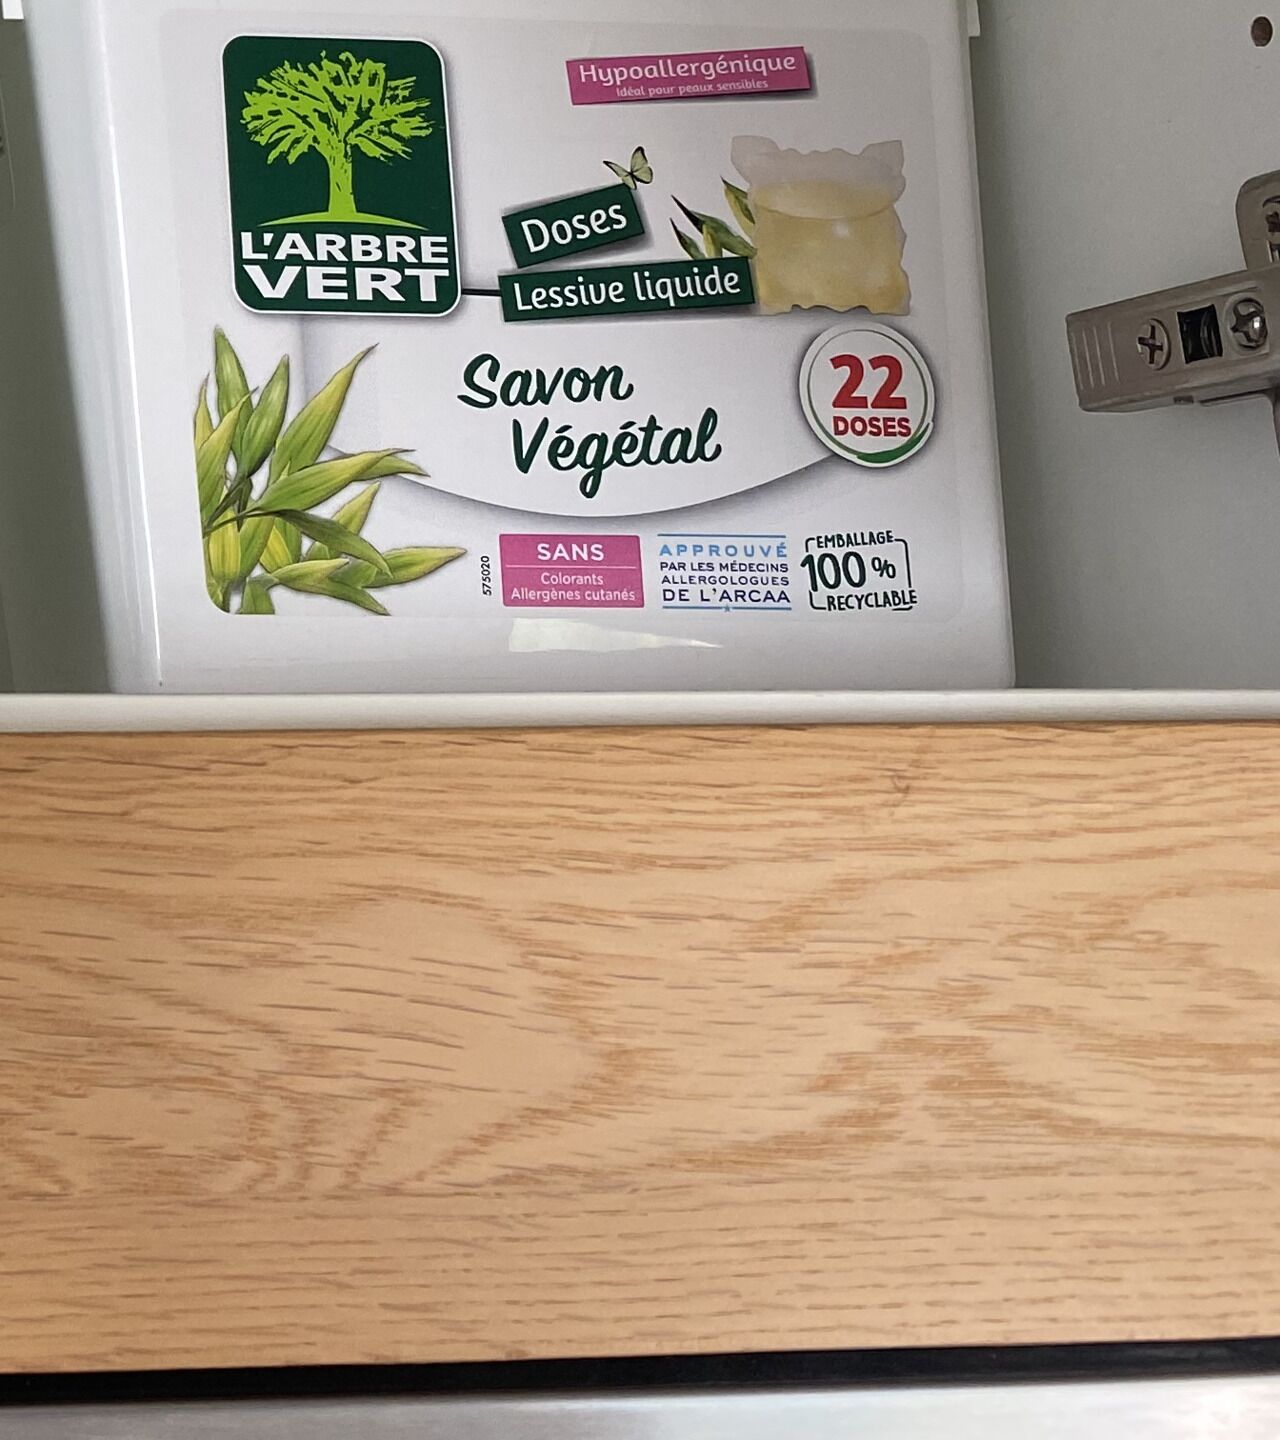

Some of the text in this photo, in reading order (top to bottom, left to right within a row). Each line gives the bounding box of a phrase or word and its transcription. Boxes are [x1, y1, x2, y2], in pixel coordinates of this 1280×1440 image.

[578, 54, 797, 86] Hypoallergénique
[616, 79, 769, 97] Idéal pour peaux sensibles
[520, 203, 627, 253] Doses
[240, 231, 449, 264] L'ARBRE
[242, 264, 450, 302] VERT
[513, 266, 741, 311] Lessive liquide
[456, 353, 634, 409] Savon
[829, 354, 907, 409] 22
[832, 416, 912, 438] DOSES
[512, 406, 722, 499] Végétal
[659, 543, 787, 558] APPROUVÉ
[816, 530, 894, 549] EMBALLAGE
[537, 543, 605, 561] SANS
[481, 555, 492, 596] 575020
[660, 560, 789, 573] PAR LES MÉDECINS
[800, 551, 896, 592] 100 %
[540, 572, 604, 586] Colorants
[661, 575, 789, 586] ALLERGOLOGUES
[510, 587, 636, 603] Allergènes cutanés
[662, 589, 690, 602] DE
[827, 590, 918, 610] RECYCLABLE
